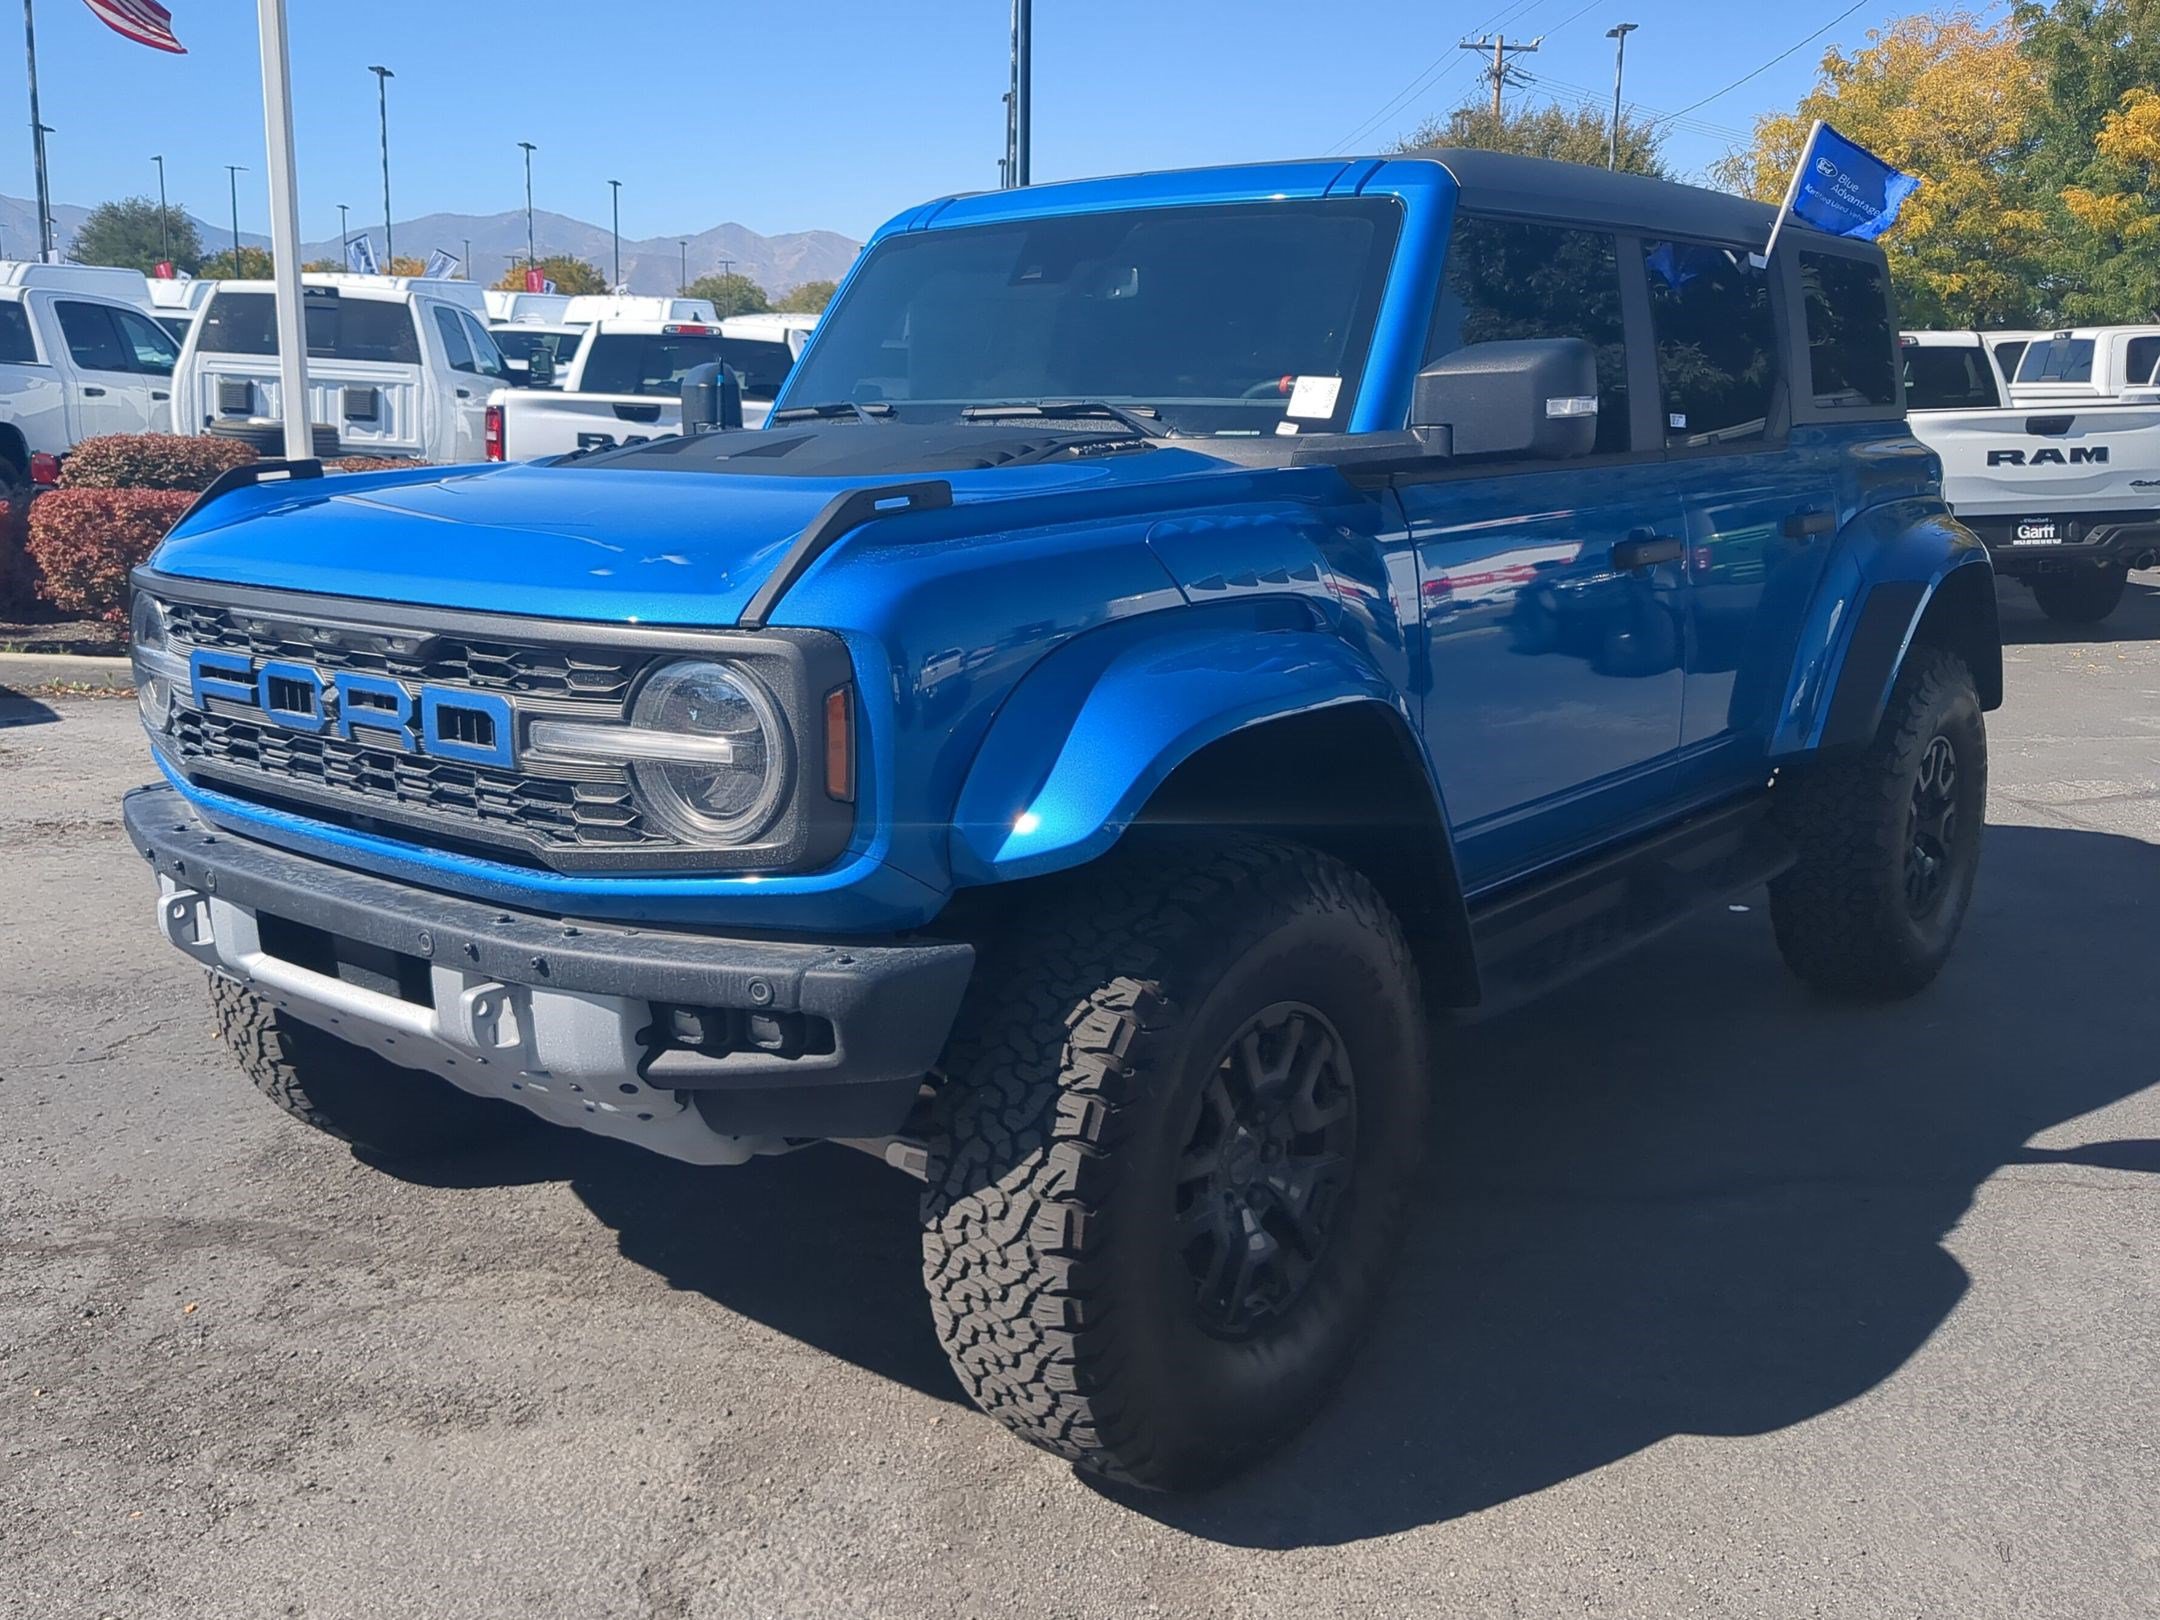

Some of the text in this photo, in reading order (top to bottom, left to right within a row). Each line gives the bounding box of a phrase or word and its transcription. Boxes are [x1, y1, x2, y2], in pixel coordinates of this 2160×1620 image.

[1838, 173, 1859, 193] Blue
[1830, 183, 1881, 217] Advantage
[1987, 446, 2110, 465] RAM
[2017, 523, 2055, 539] Garff
[189, 647, 518, 769] FORD
